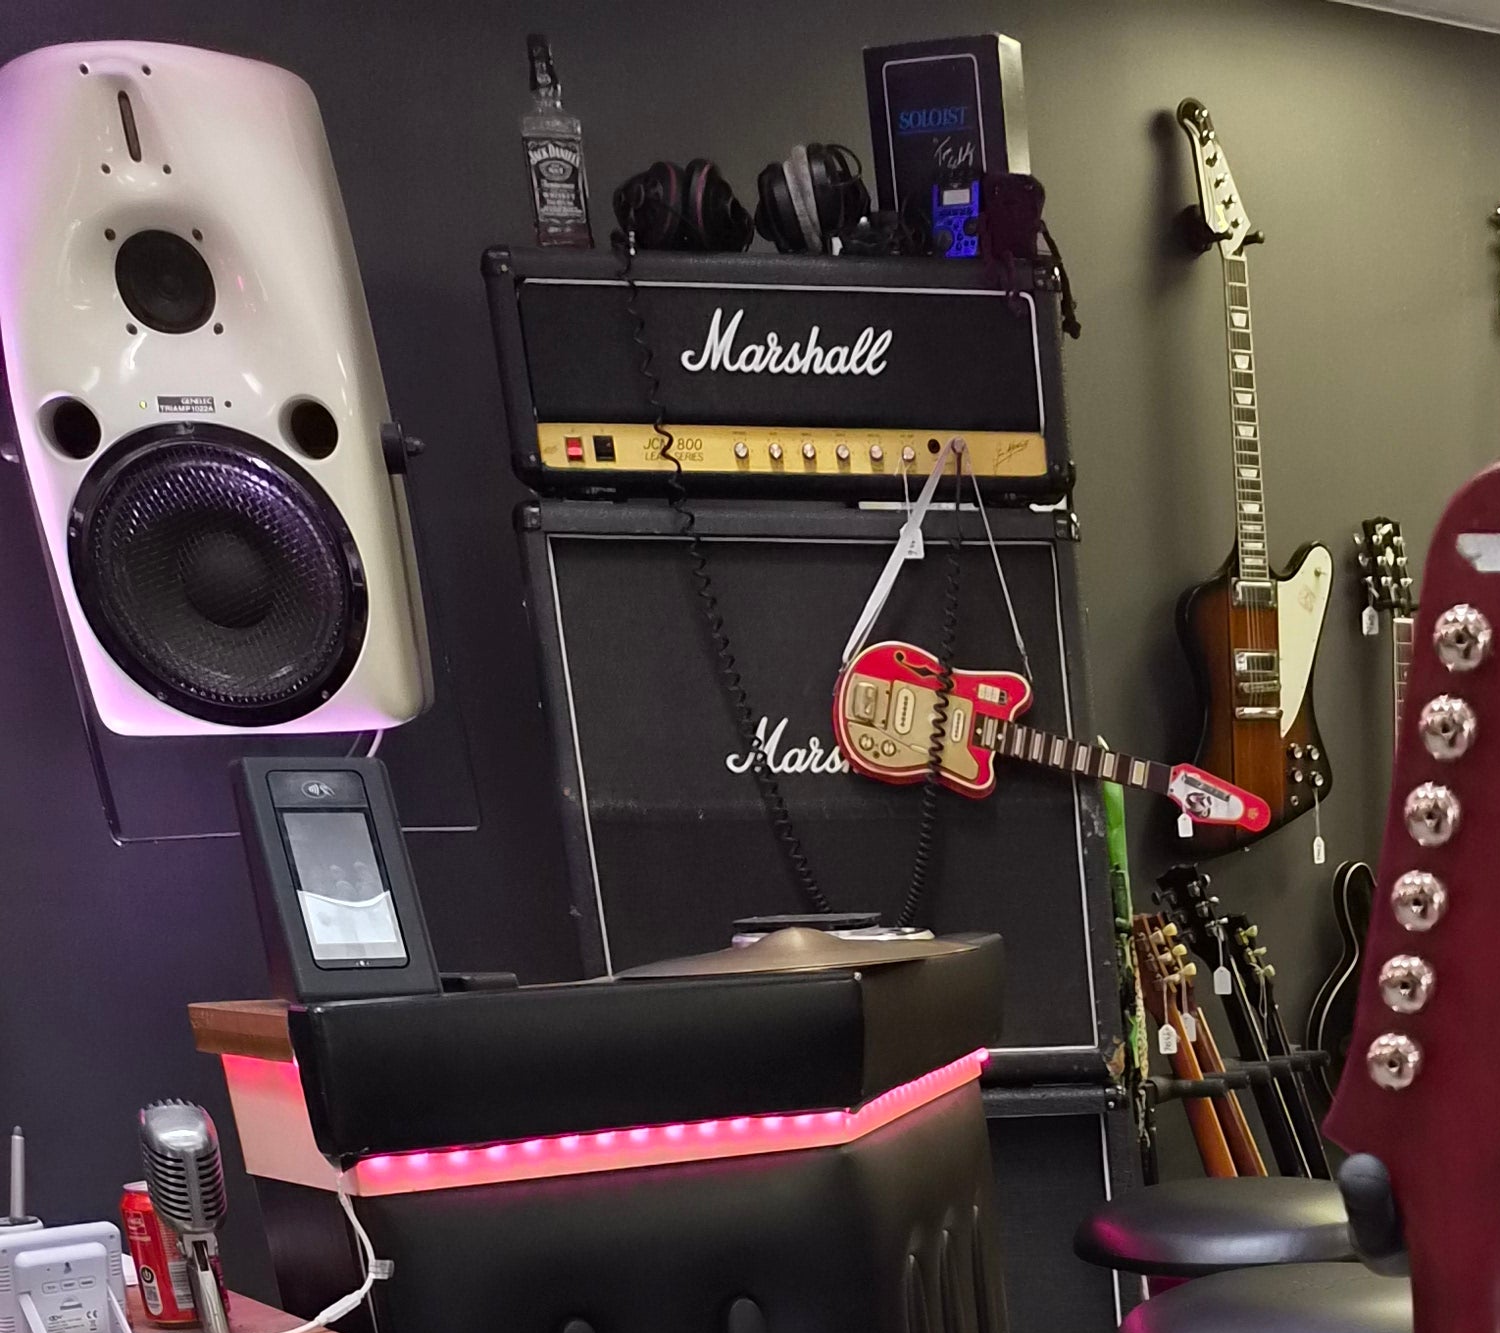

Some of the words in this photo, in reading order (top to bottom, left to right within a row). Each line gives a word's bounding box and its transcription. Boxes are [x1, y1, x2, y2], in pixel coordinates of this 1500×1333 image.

[900, 106, 968, 129] SOLOIST
[681, 308, 892, 376] Marshall
[677, 437, 703, 451] 800
[726, 716, 850, 773] Mars
